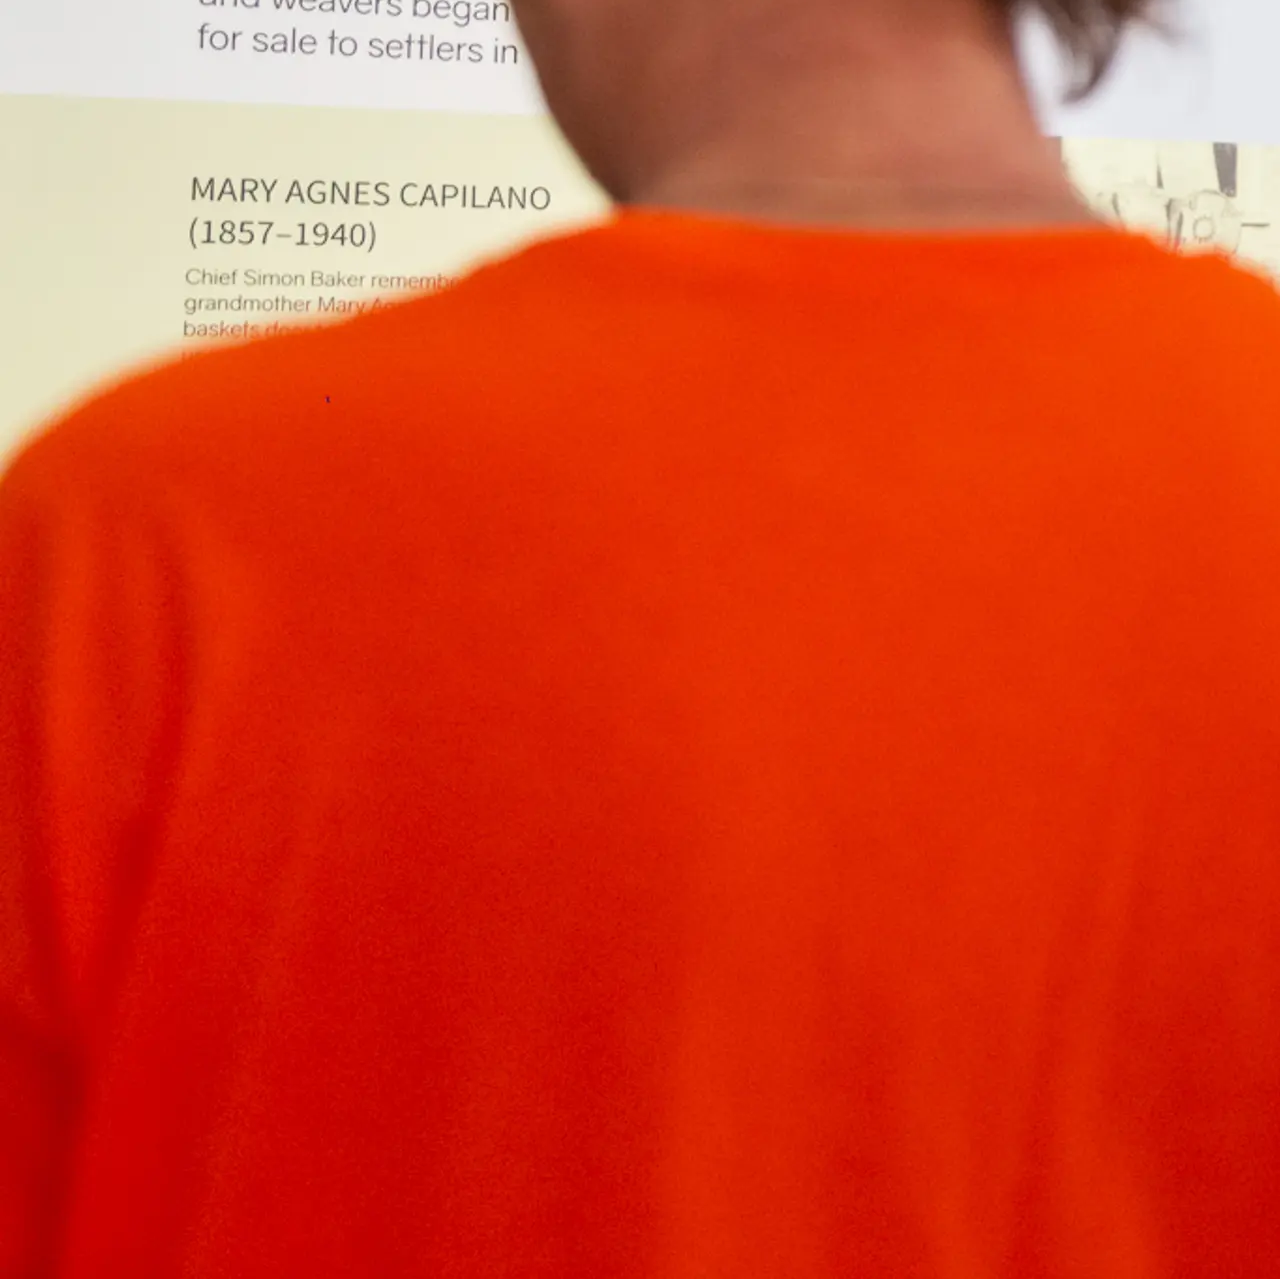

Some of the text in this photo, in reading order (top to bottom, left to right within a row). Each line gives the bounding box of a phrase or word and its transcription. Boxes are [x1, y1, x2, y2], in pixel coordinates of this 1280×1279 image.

[198, 23, 517, 63] for sale to settlers in
[191, 177, 550, 209] MARY AGNES CAPILANO
[188, 219, 376, 249] (1857–1940)
[184, 269, 238, 286] Chief
[243, 269, 306, 287] Simon
[309, 270, 364, 288] Baker
[183, 294, 310, 316] grandmother
[317, 295, 364, 317] Mary
[183, 319, 259, 337] baskets
